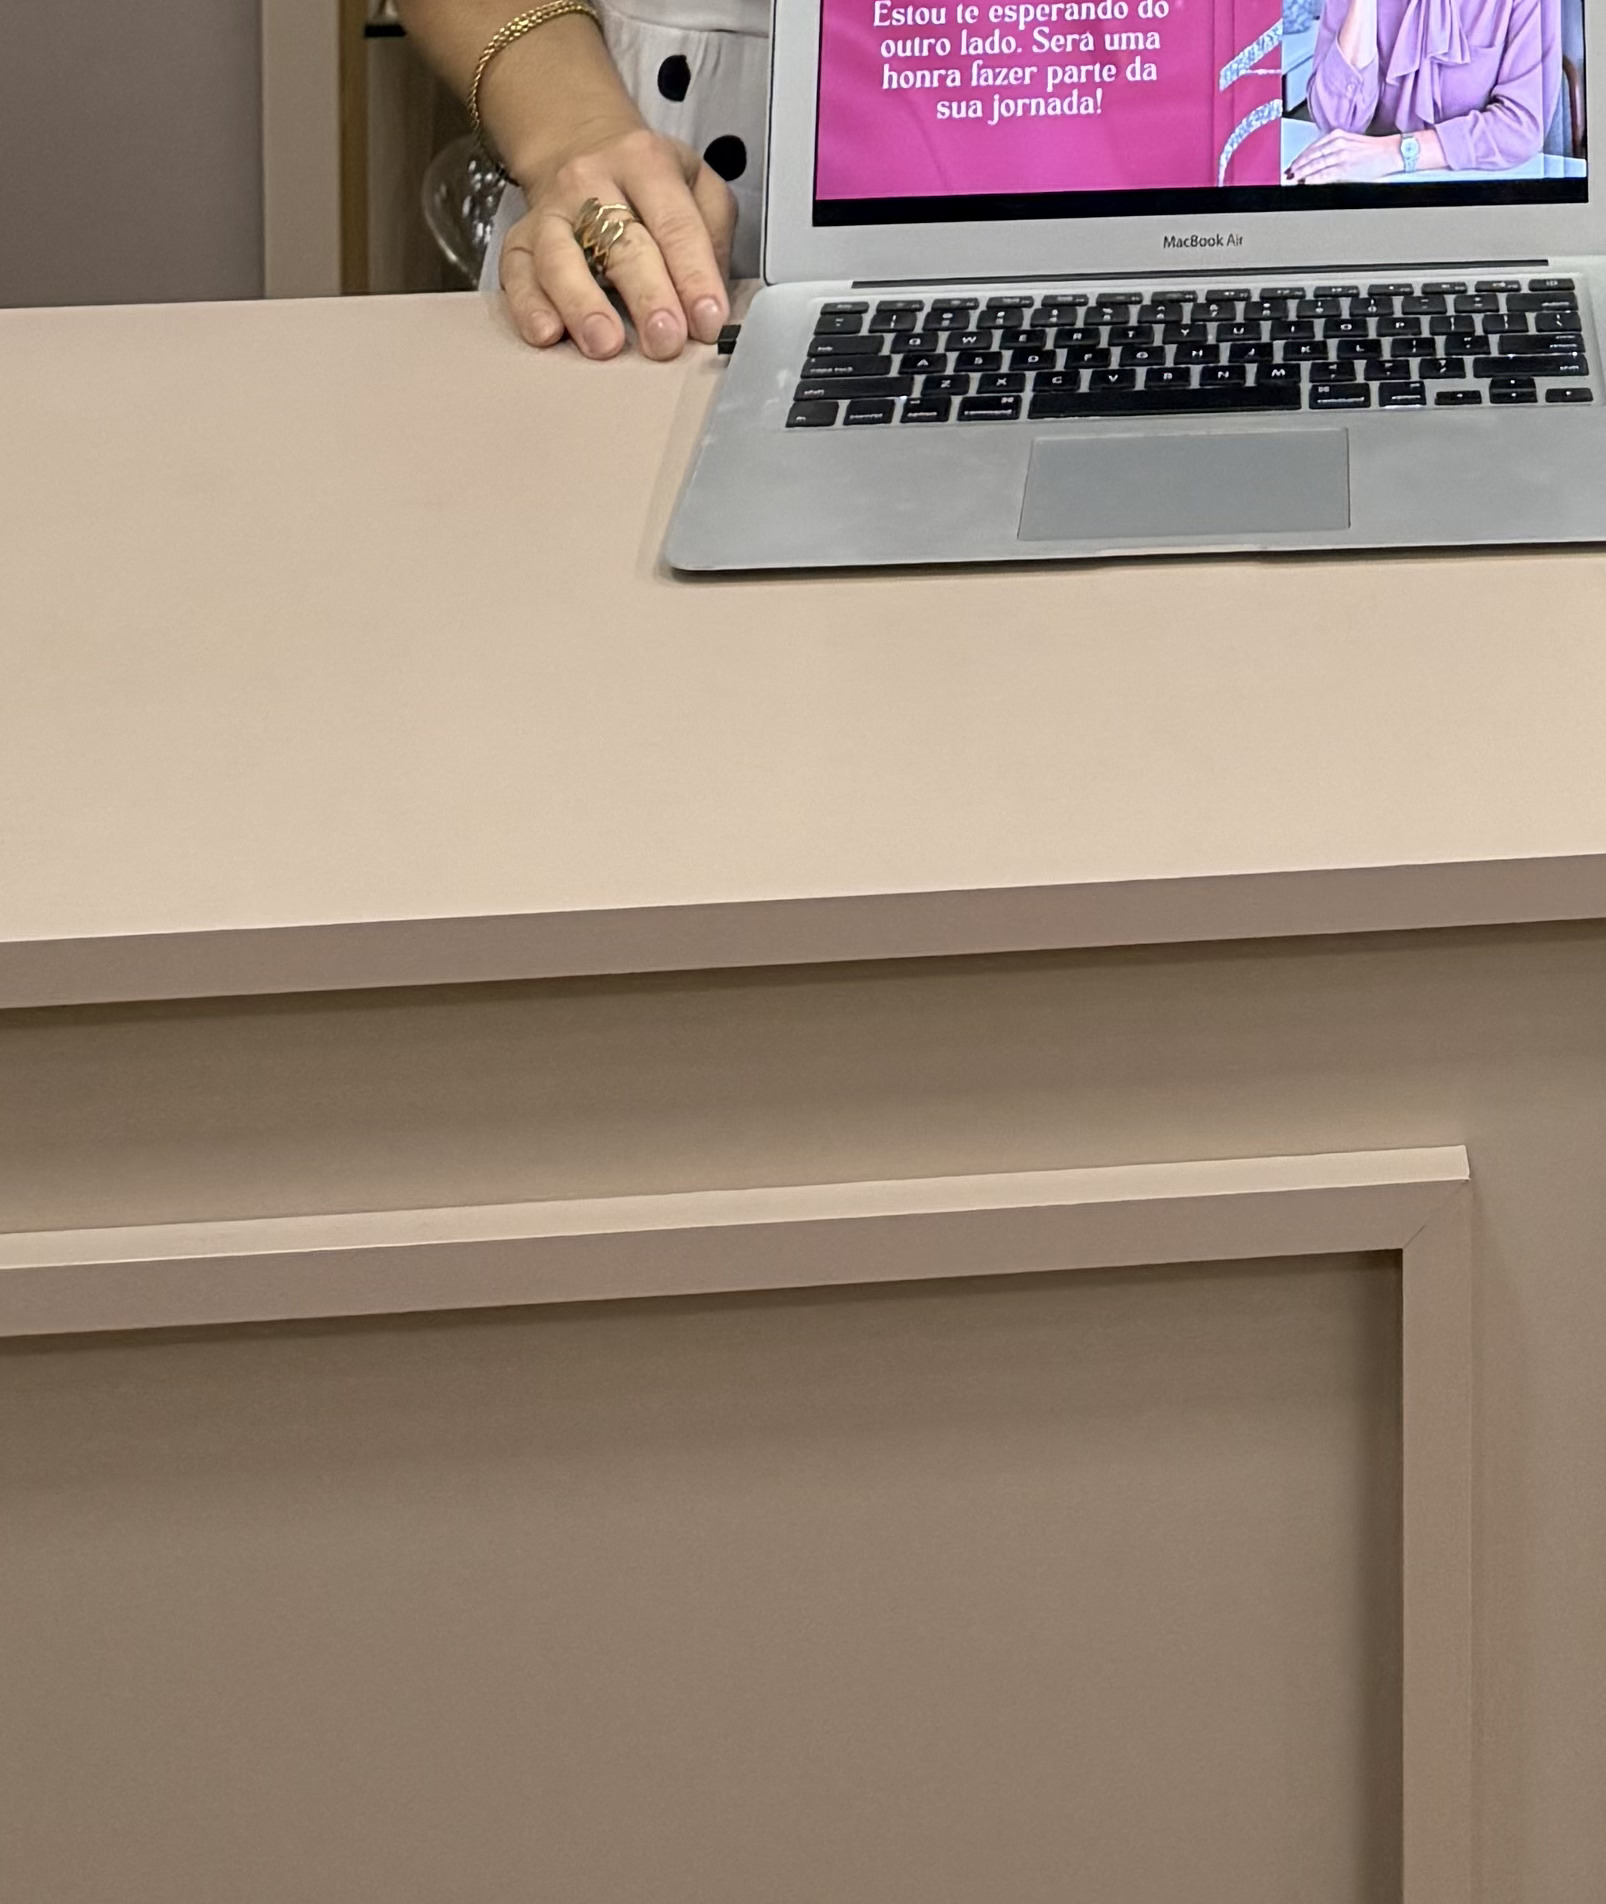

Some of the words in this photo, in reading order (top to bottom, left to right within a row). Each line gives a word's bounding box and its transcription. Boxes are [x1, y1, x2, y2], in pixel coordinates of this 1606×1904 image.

[873, 0, 946, 27] Estou
[956, 4, 979, 24] te
[880, 37, 951, 58] outro
[960, 29, 1023, 56] lado.
[1104, 31, 1161, 51] uma
[882, 63, 961, 89] honra
[971, 59, 1038, 87] fazer
[1046, 63, 1117, 92] parte
[1125, 55, 1157, 82] da
[936, 100, 983, 119] sua
[987, 88, 1103, 125] jornada!
[1163, 234, 1224, 248] MacBook
